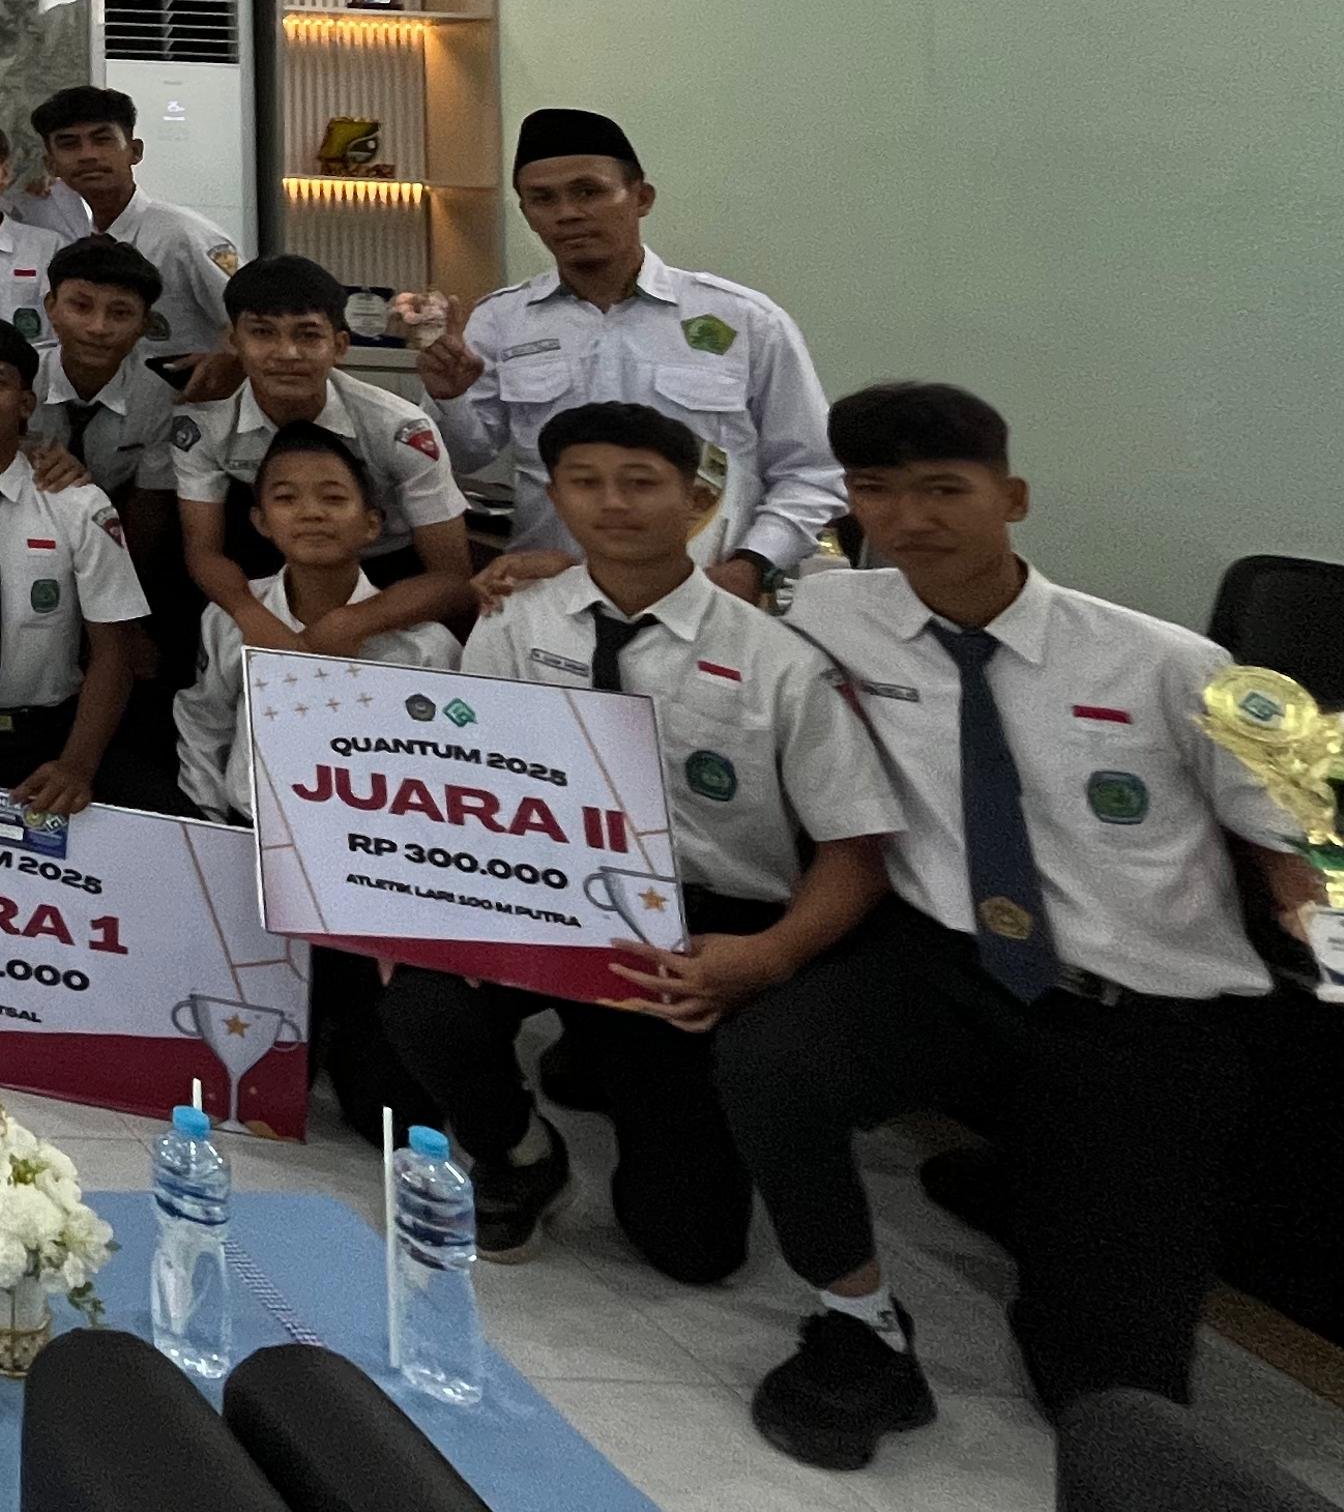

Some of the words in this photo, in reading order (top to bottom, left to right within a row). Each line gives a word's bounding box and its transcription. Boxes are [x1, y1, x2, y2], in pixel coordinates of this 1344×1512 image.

[330, 736, 481, 765] QUANTUM
[486, 752, 569, 788] 2025
[291, 763, 571, 845] JUARA
[581, 806, 629, 854] II
[17, 855, 103, 896] 2025
[347, 832, 398, 857] RP
[404, 843, 569, 890] 300.000
[88, 915, 129, 956] 1
[514, 904, 583, 929] PUTRA
